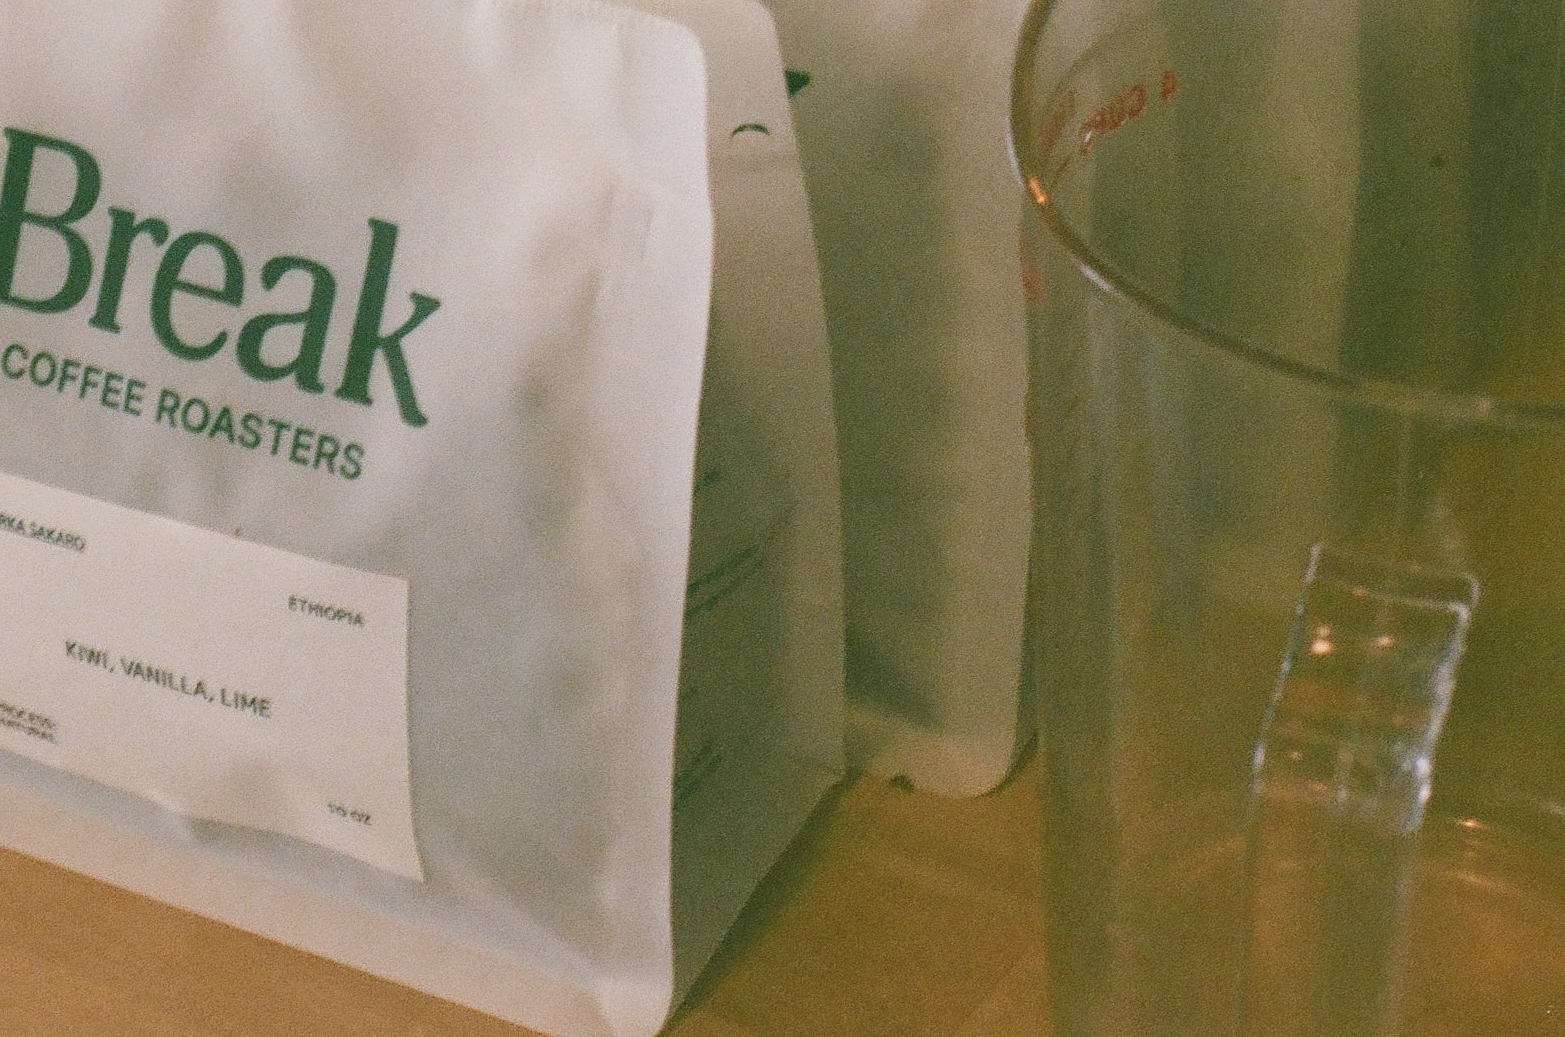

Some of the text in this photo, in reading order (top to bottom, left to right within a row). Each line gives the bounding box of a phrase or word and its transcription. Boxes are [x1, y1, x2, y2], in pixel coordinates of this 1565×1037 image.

[0, 343, 366, 481] COFFEE ROASTERS
[286, 592, 366, 628] ETHIOPIA
[64, 639, 272, 720] KIWI, VANILLA, LIME
